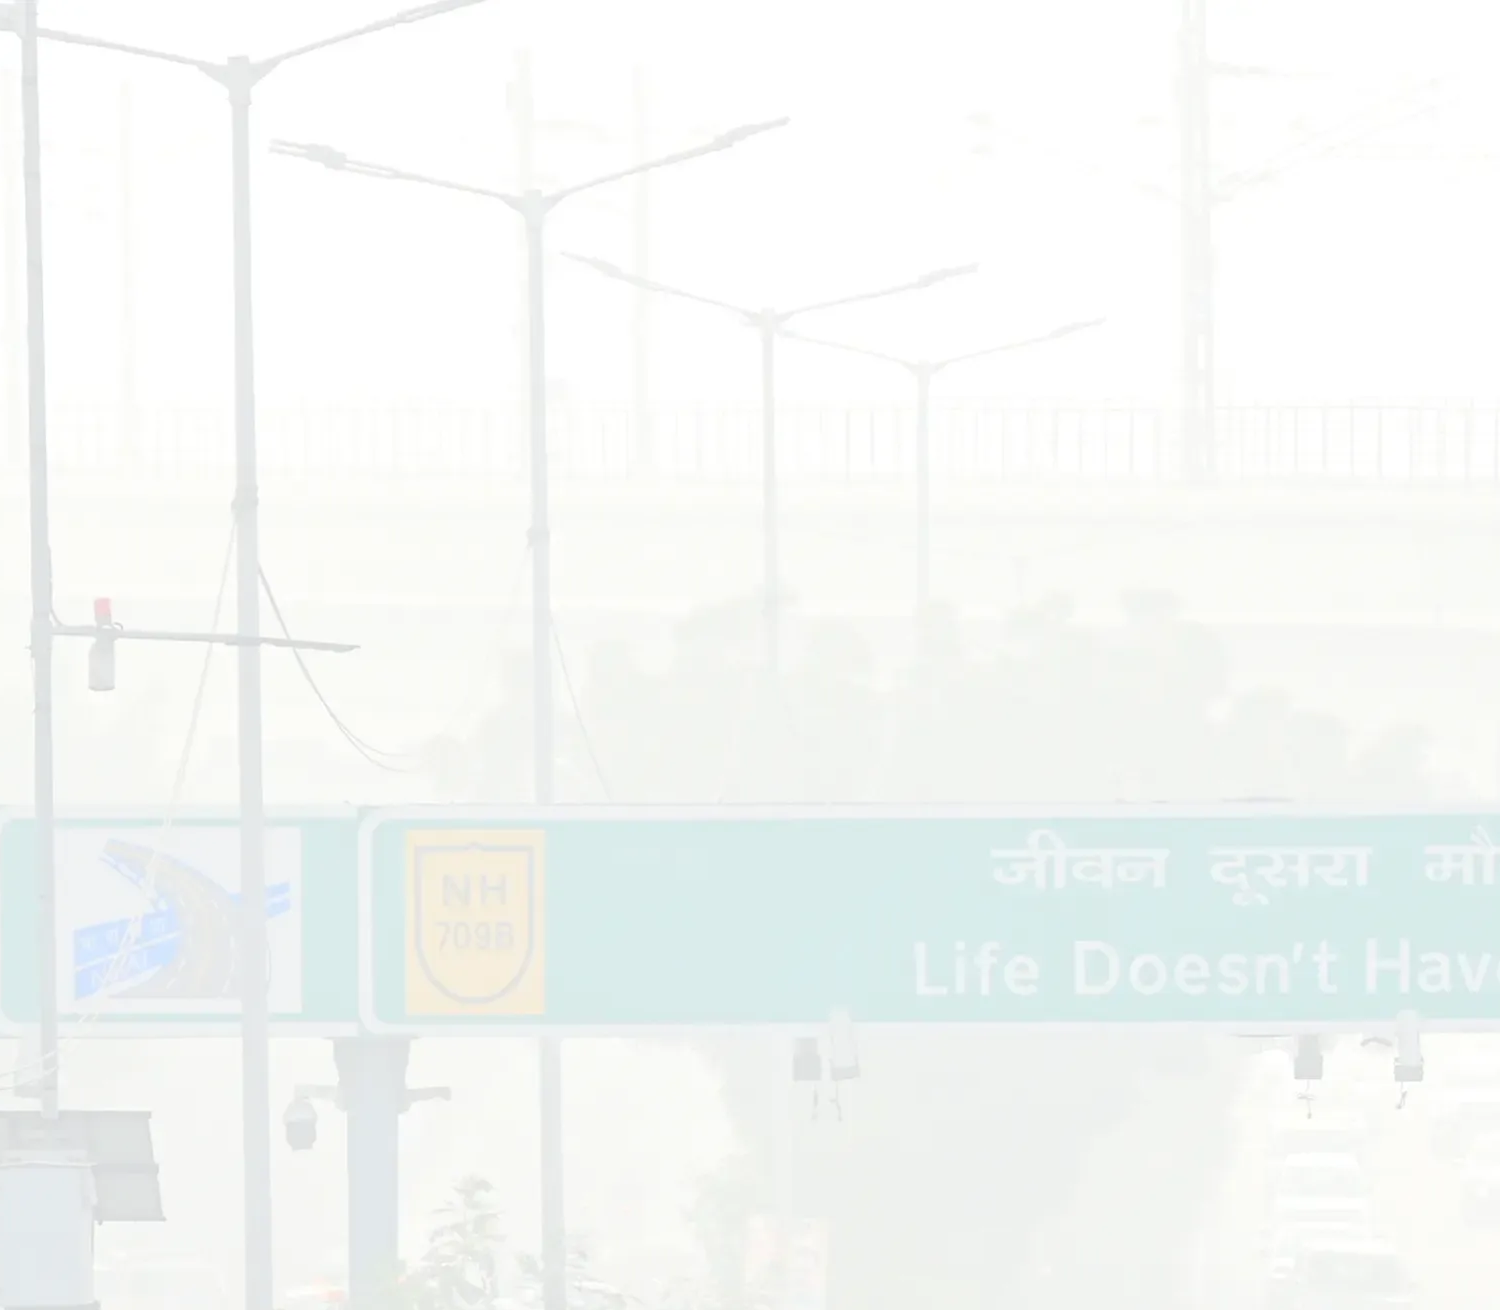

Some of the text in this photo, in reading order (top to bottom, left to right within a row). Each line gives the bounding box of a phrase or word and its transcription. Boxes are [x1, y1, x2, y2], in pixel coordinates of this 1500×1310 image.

[442, 873, 508, 907] NH
[989, 828, 1171, 891] जीवन
[1207, 843, 1373, 906] दूसरा
[913, 940, 1041, 998] Life
[1072, 938, 1337, 997] Doesn't
